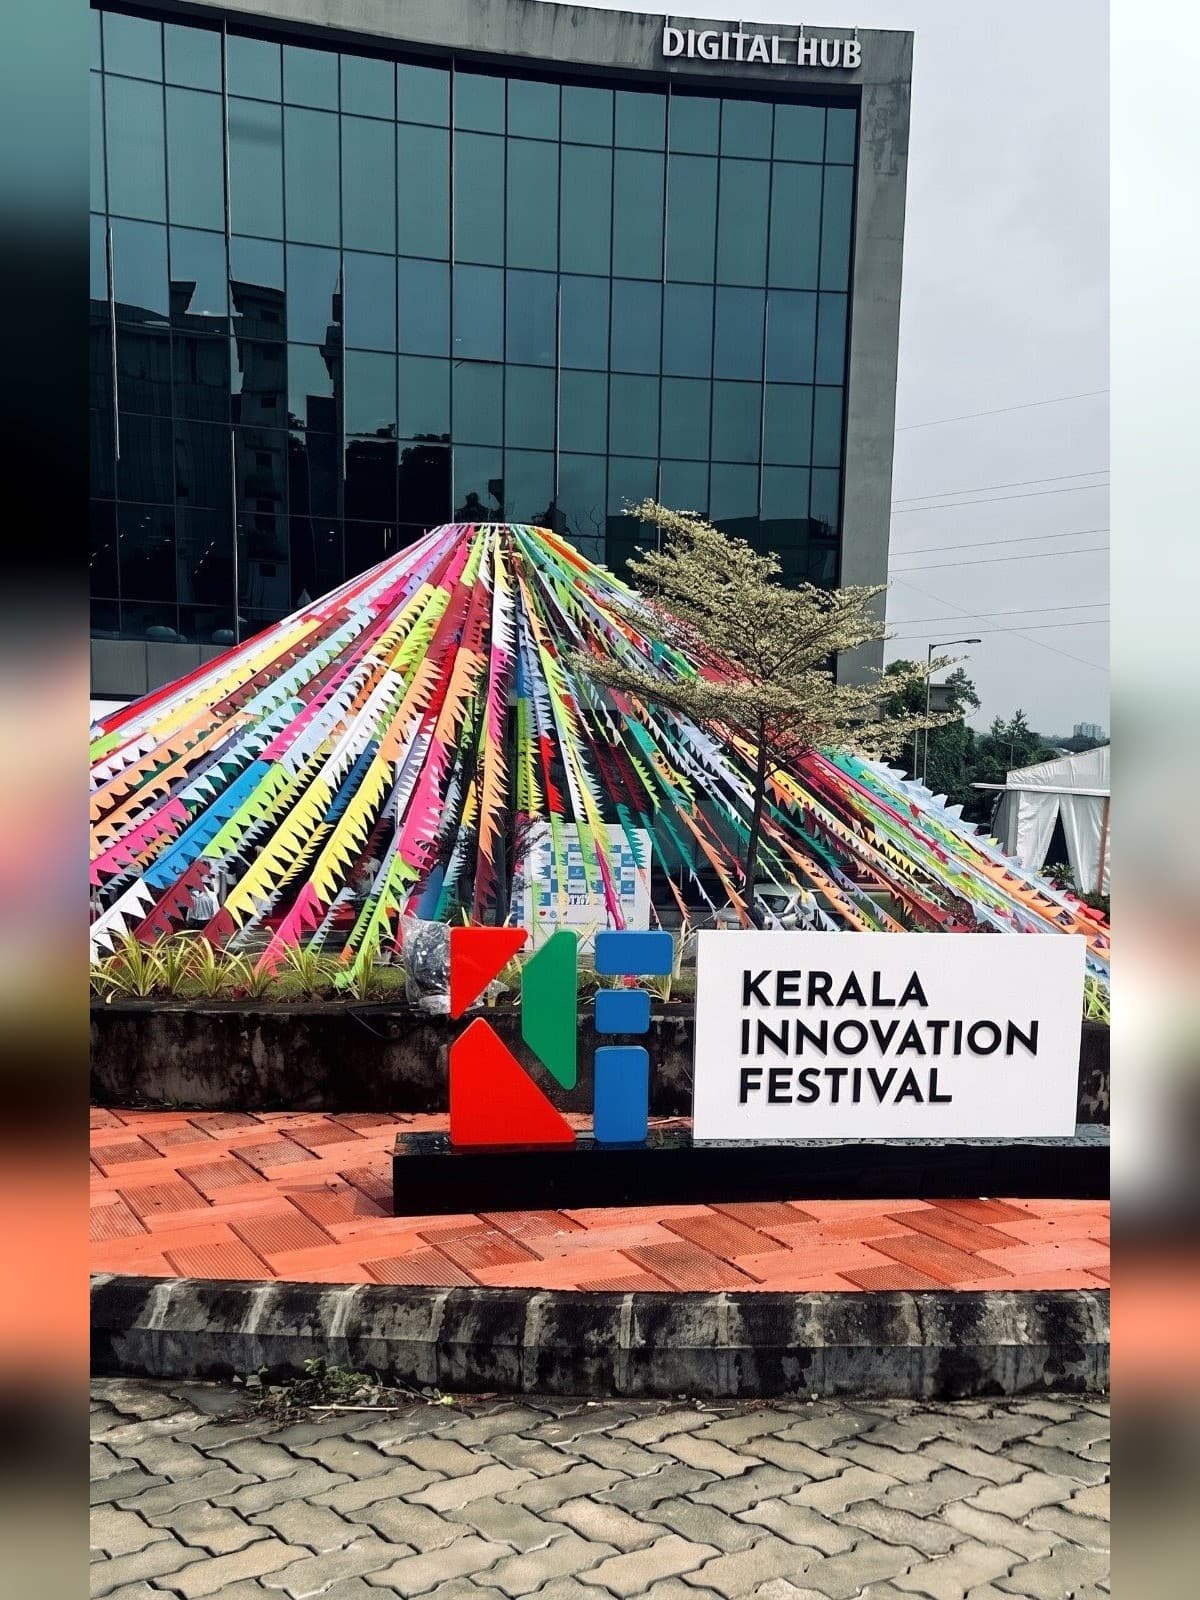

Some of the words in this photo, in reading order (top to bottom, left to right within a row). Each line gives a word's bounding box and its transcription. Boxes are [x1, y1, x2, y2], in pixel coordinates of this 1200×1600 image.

[662, 27, 786, 64] DIGITAL
[798, 37, 862, 69] HUB
[742, 970, 929, 1007] KERALA
[741, 1018, 1039, 1056] INNOVATION
[739, 1067, 953, 1104] FESTIVAL
